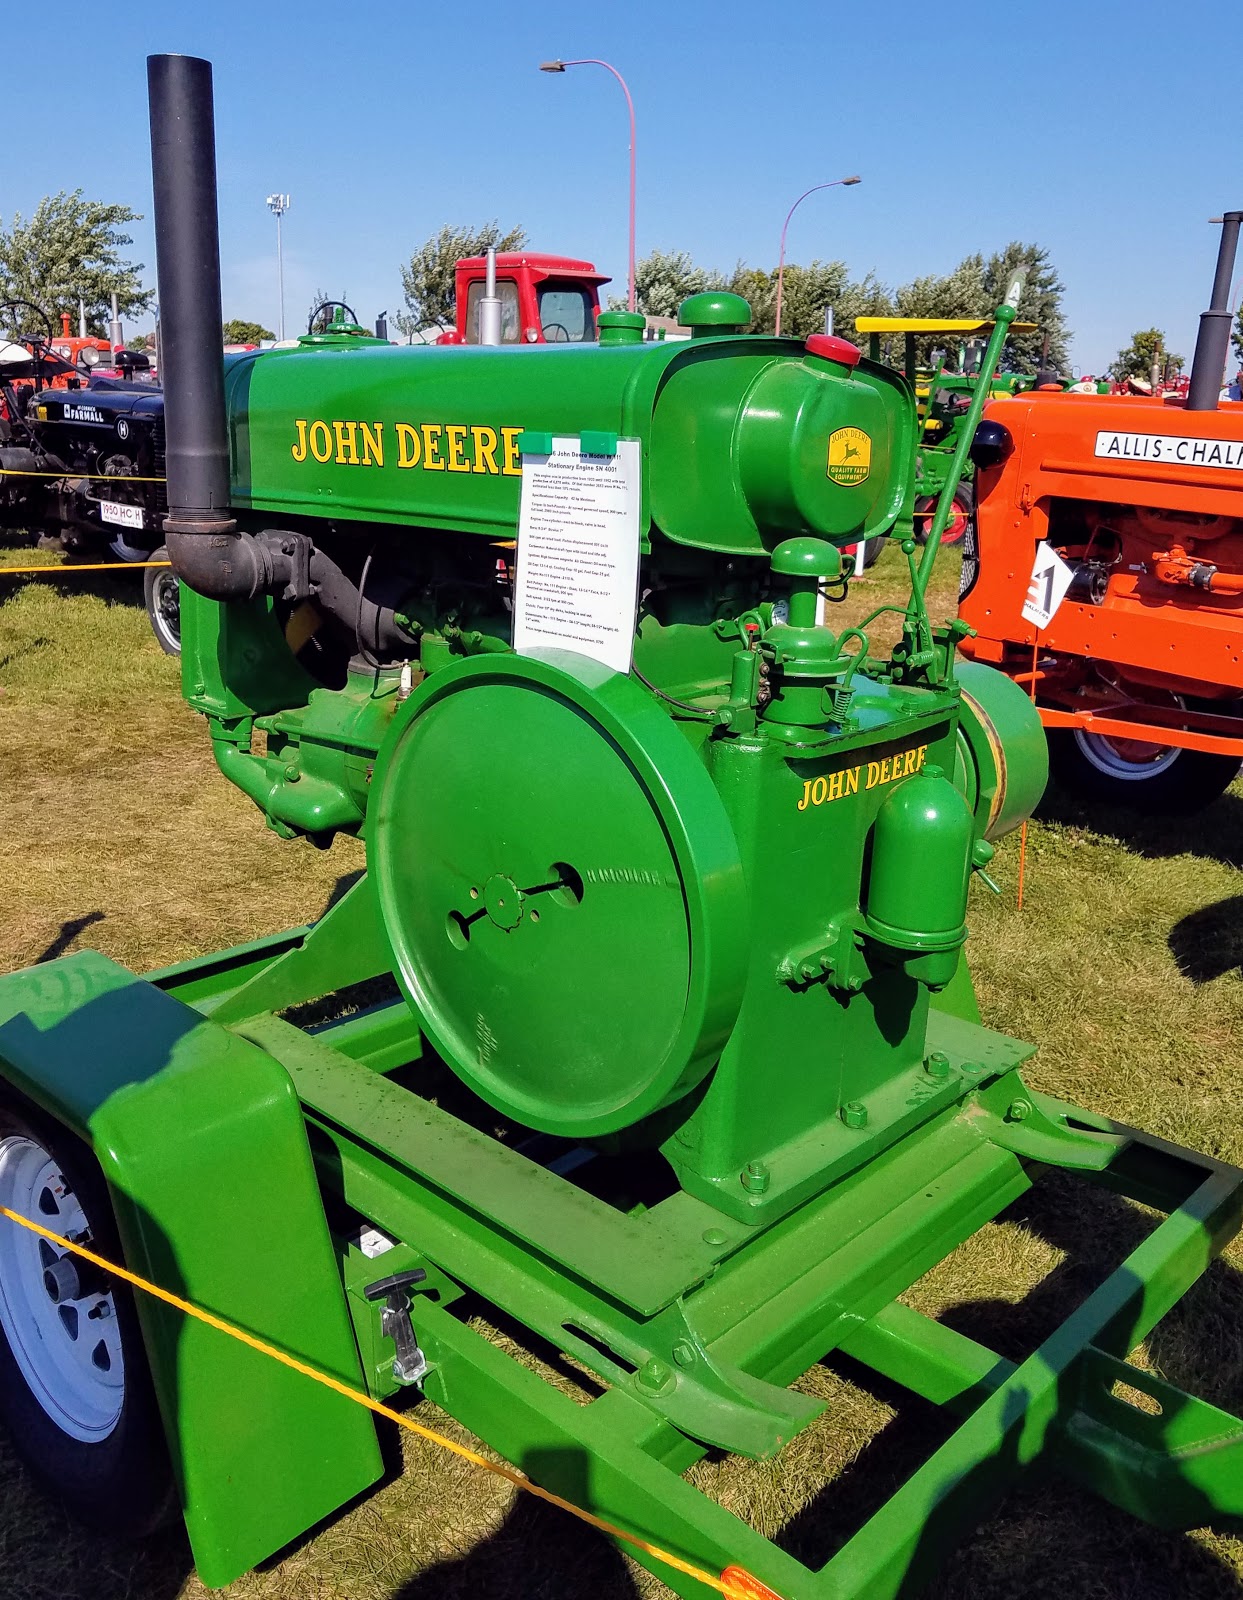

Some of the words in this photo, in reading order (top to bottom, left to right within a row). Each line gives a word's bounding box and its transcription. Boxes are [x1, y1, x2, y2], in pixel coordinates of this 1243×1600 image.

[71, 408, 104, 423] FARMALL
[120, 422, 126, 436] H
[831, 429, 849, 444] JOHN
[851, 430, 868, 445] DEERE
[291, 418, 384, 467] JOHN
[394, 422, 525, 476] DEERE
[1107, 436, 1243, 465] ALLIS-CHAL
[548, 462, 575, 471] Stationary
[1034, 564, 1055, 614] 1
[797, 765, 861, 811] JOHN
[865, 744, 928, 790] DEERE
